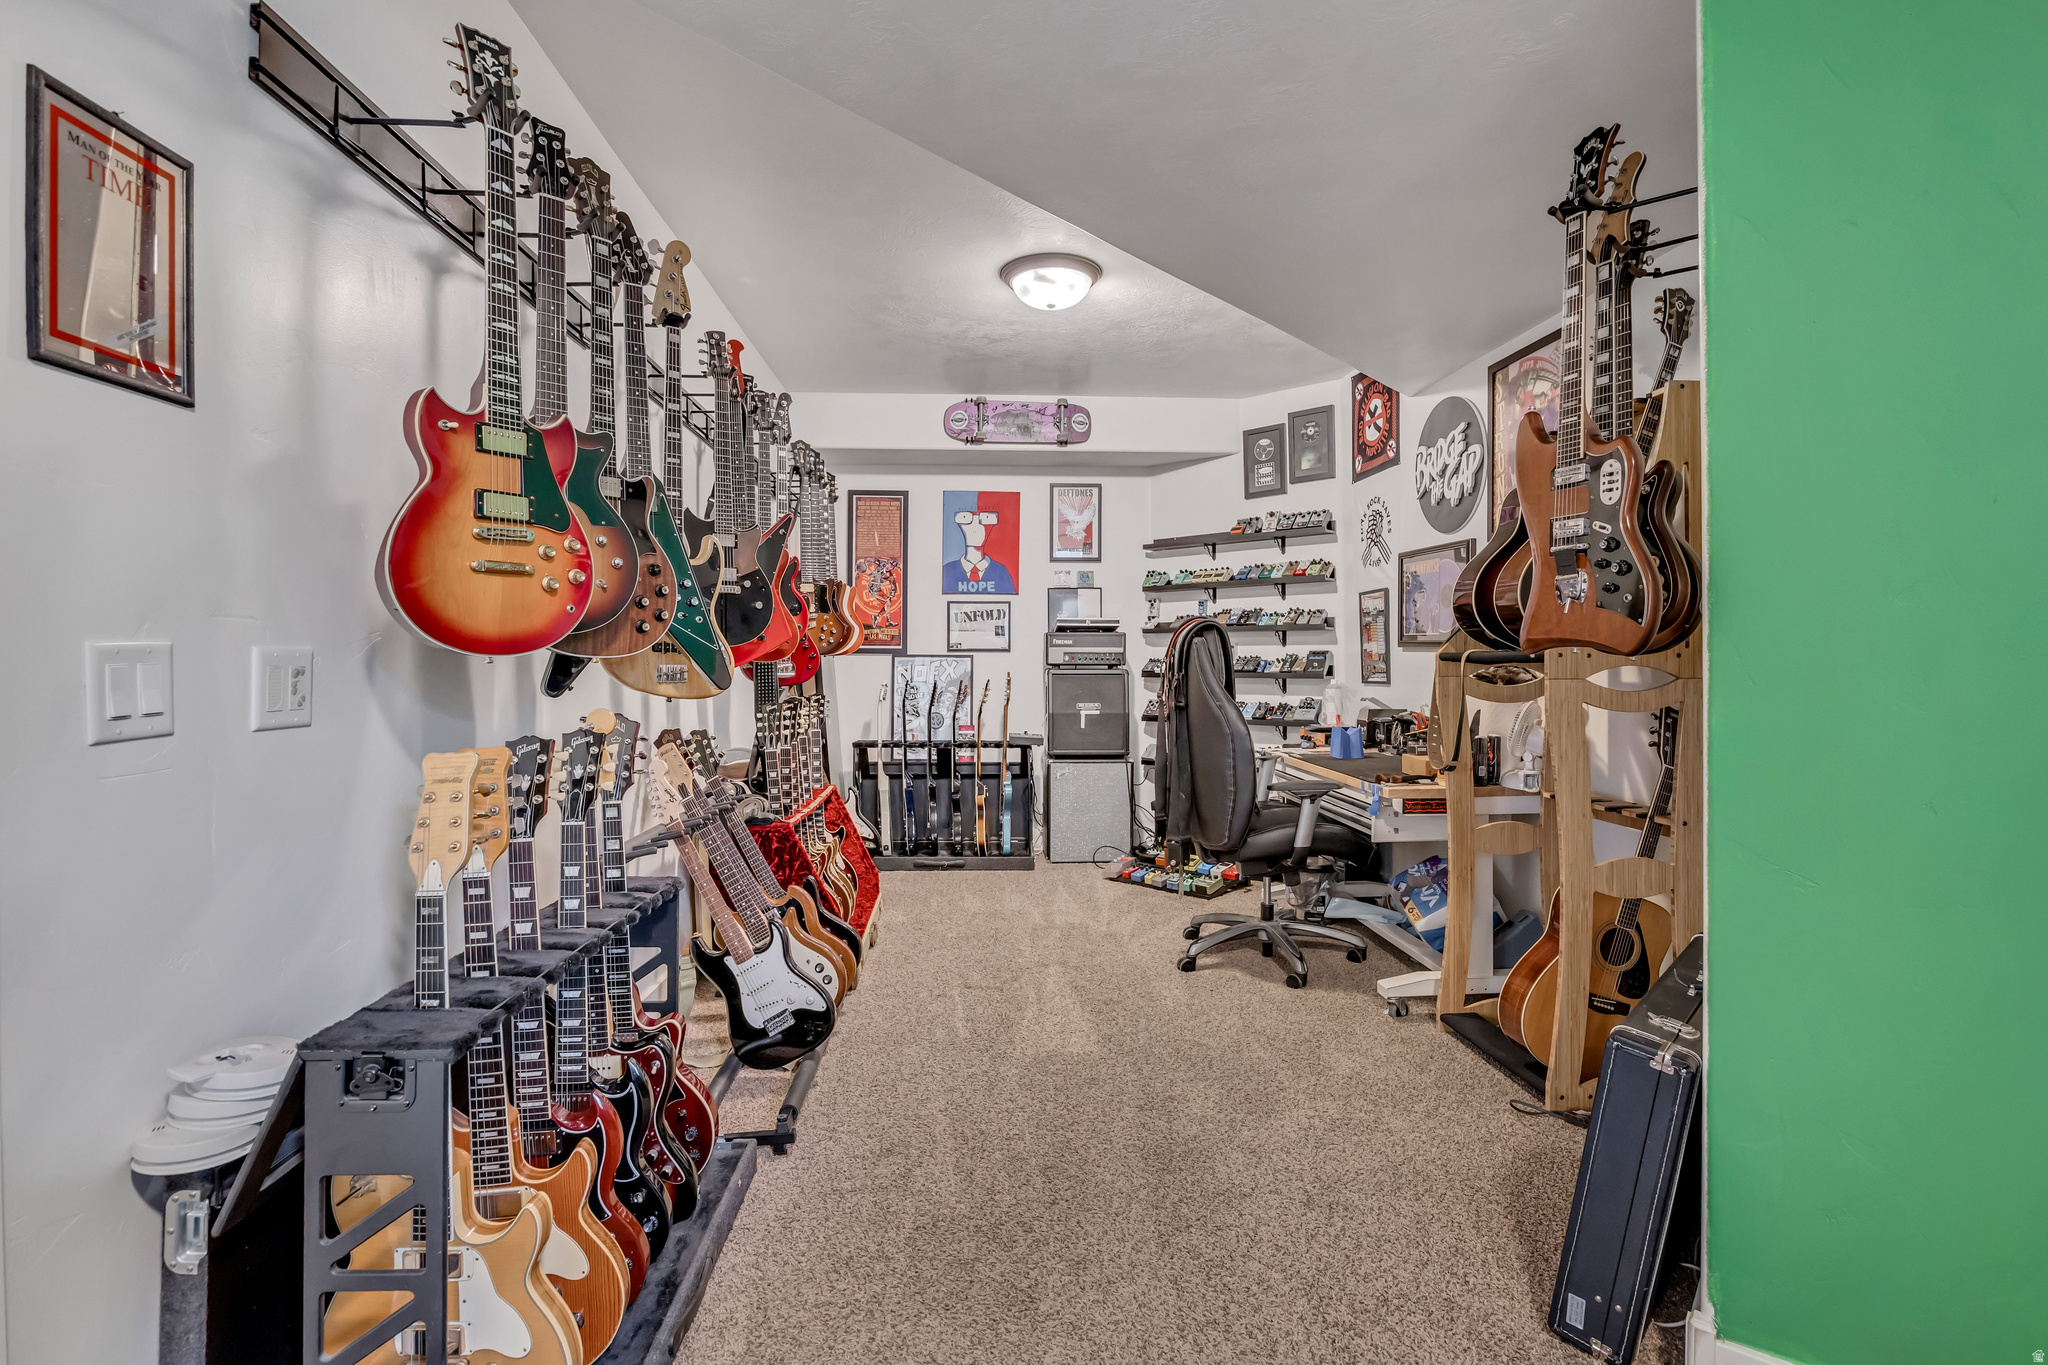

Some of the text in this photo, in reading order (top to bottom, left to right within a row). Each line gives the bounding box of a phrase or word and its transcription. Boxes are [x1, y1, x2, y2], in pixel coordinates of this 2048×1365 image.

[474, 34, 500, 51] YAMAHA
[68, 130, 96, 155] MAN
[114, 158, 134, 177] THE
[135, 168, 162, 192] YEAR
[81, 153, 151, 211] TIME
[1443, 443, 1484, 507] GAP
[1057, 488, 1094, 497] DEFTONES
[957, 580, 996, 593] HOPE
[953, 608, 1007, 624] UNFOLD
[896, 657, 960, 685] NOFX
[516, 742, 541, 758] Gibson
[571, 735, 594, 749] Gibson
